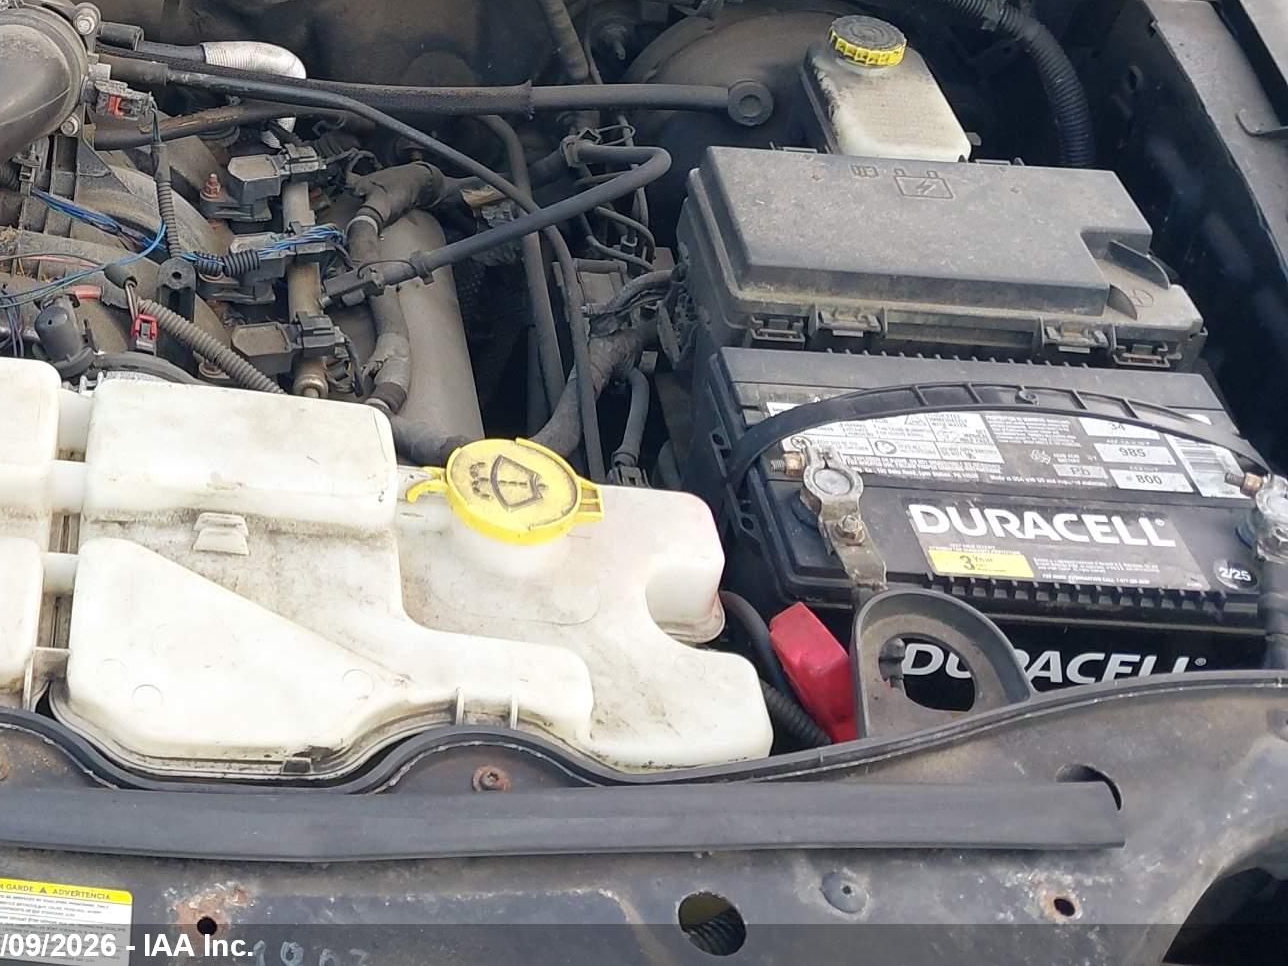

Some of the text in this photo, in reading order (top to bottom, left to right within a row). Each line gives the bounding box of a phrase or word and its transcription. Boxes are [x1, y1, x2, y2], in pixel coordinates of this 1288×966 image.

[1118, 446, 1147, 458] 985
[1135, 474, 1163, 485] 800
[908, 503, 1177, 548] DURACELL
[959, 555, 976, 571] 3
[1217, 566, 1252, 582] 2/25
[6, 882, 34, 893] GARDE
[52, 888, 112, 901] ADVERTENCIA
